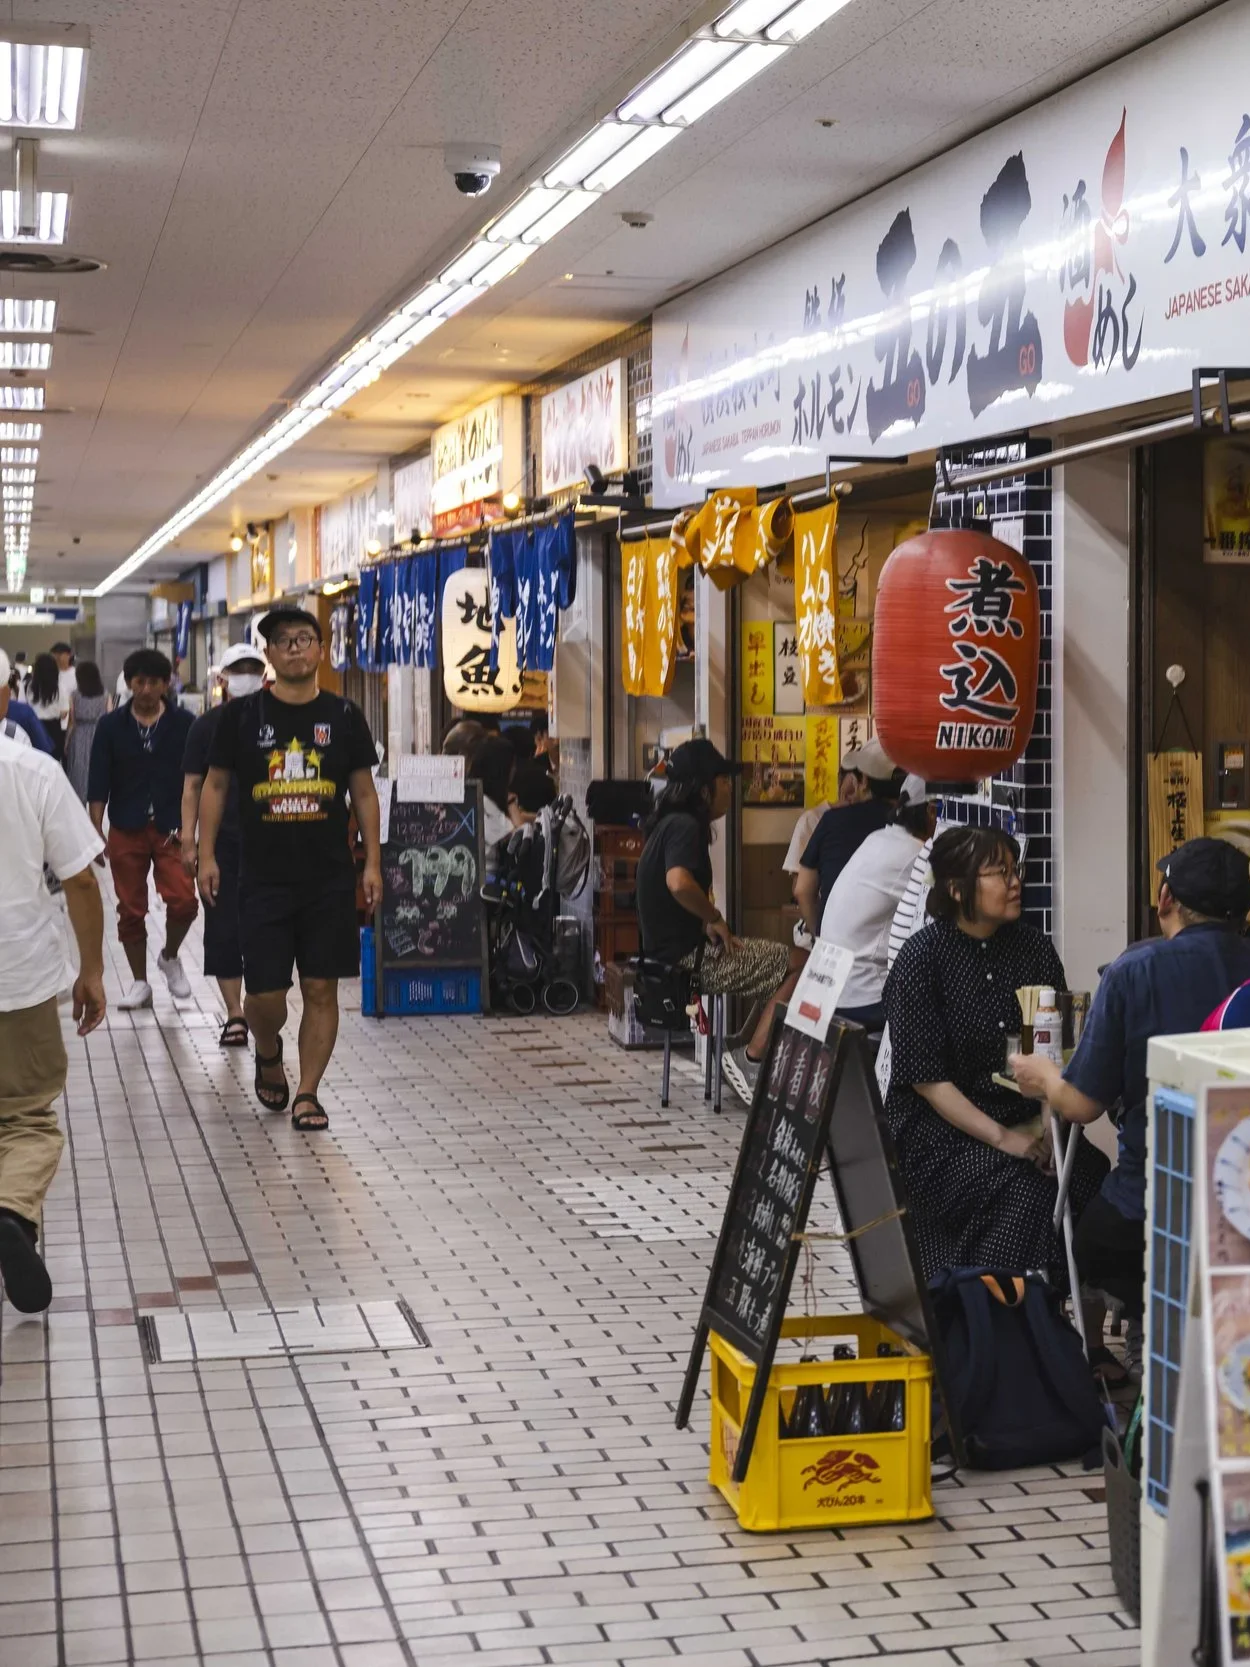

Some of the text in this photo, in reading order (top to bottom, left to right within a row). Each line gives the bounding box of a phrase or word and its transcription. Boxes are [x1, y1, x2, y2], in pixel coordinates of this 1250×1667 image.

[1092, 273, 1143, 375] めし
[1164, 289, 1221, 320] JAPANESE
[907, 378, 920, 407] GO
[1019, 343, 1036, 376] GO
[792, 364, 862, 446] ホルモン
[455, 586, 506, 697] 地魚
[939, 556, 1027, 723] 煮込
[938, 724, 1014, 749] NIKOMI
[771, 1039, 829, 1109] 新看板
